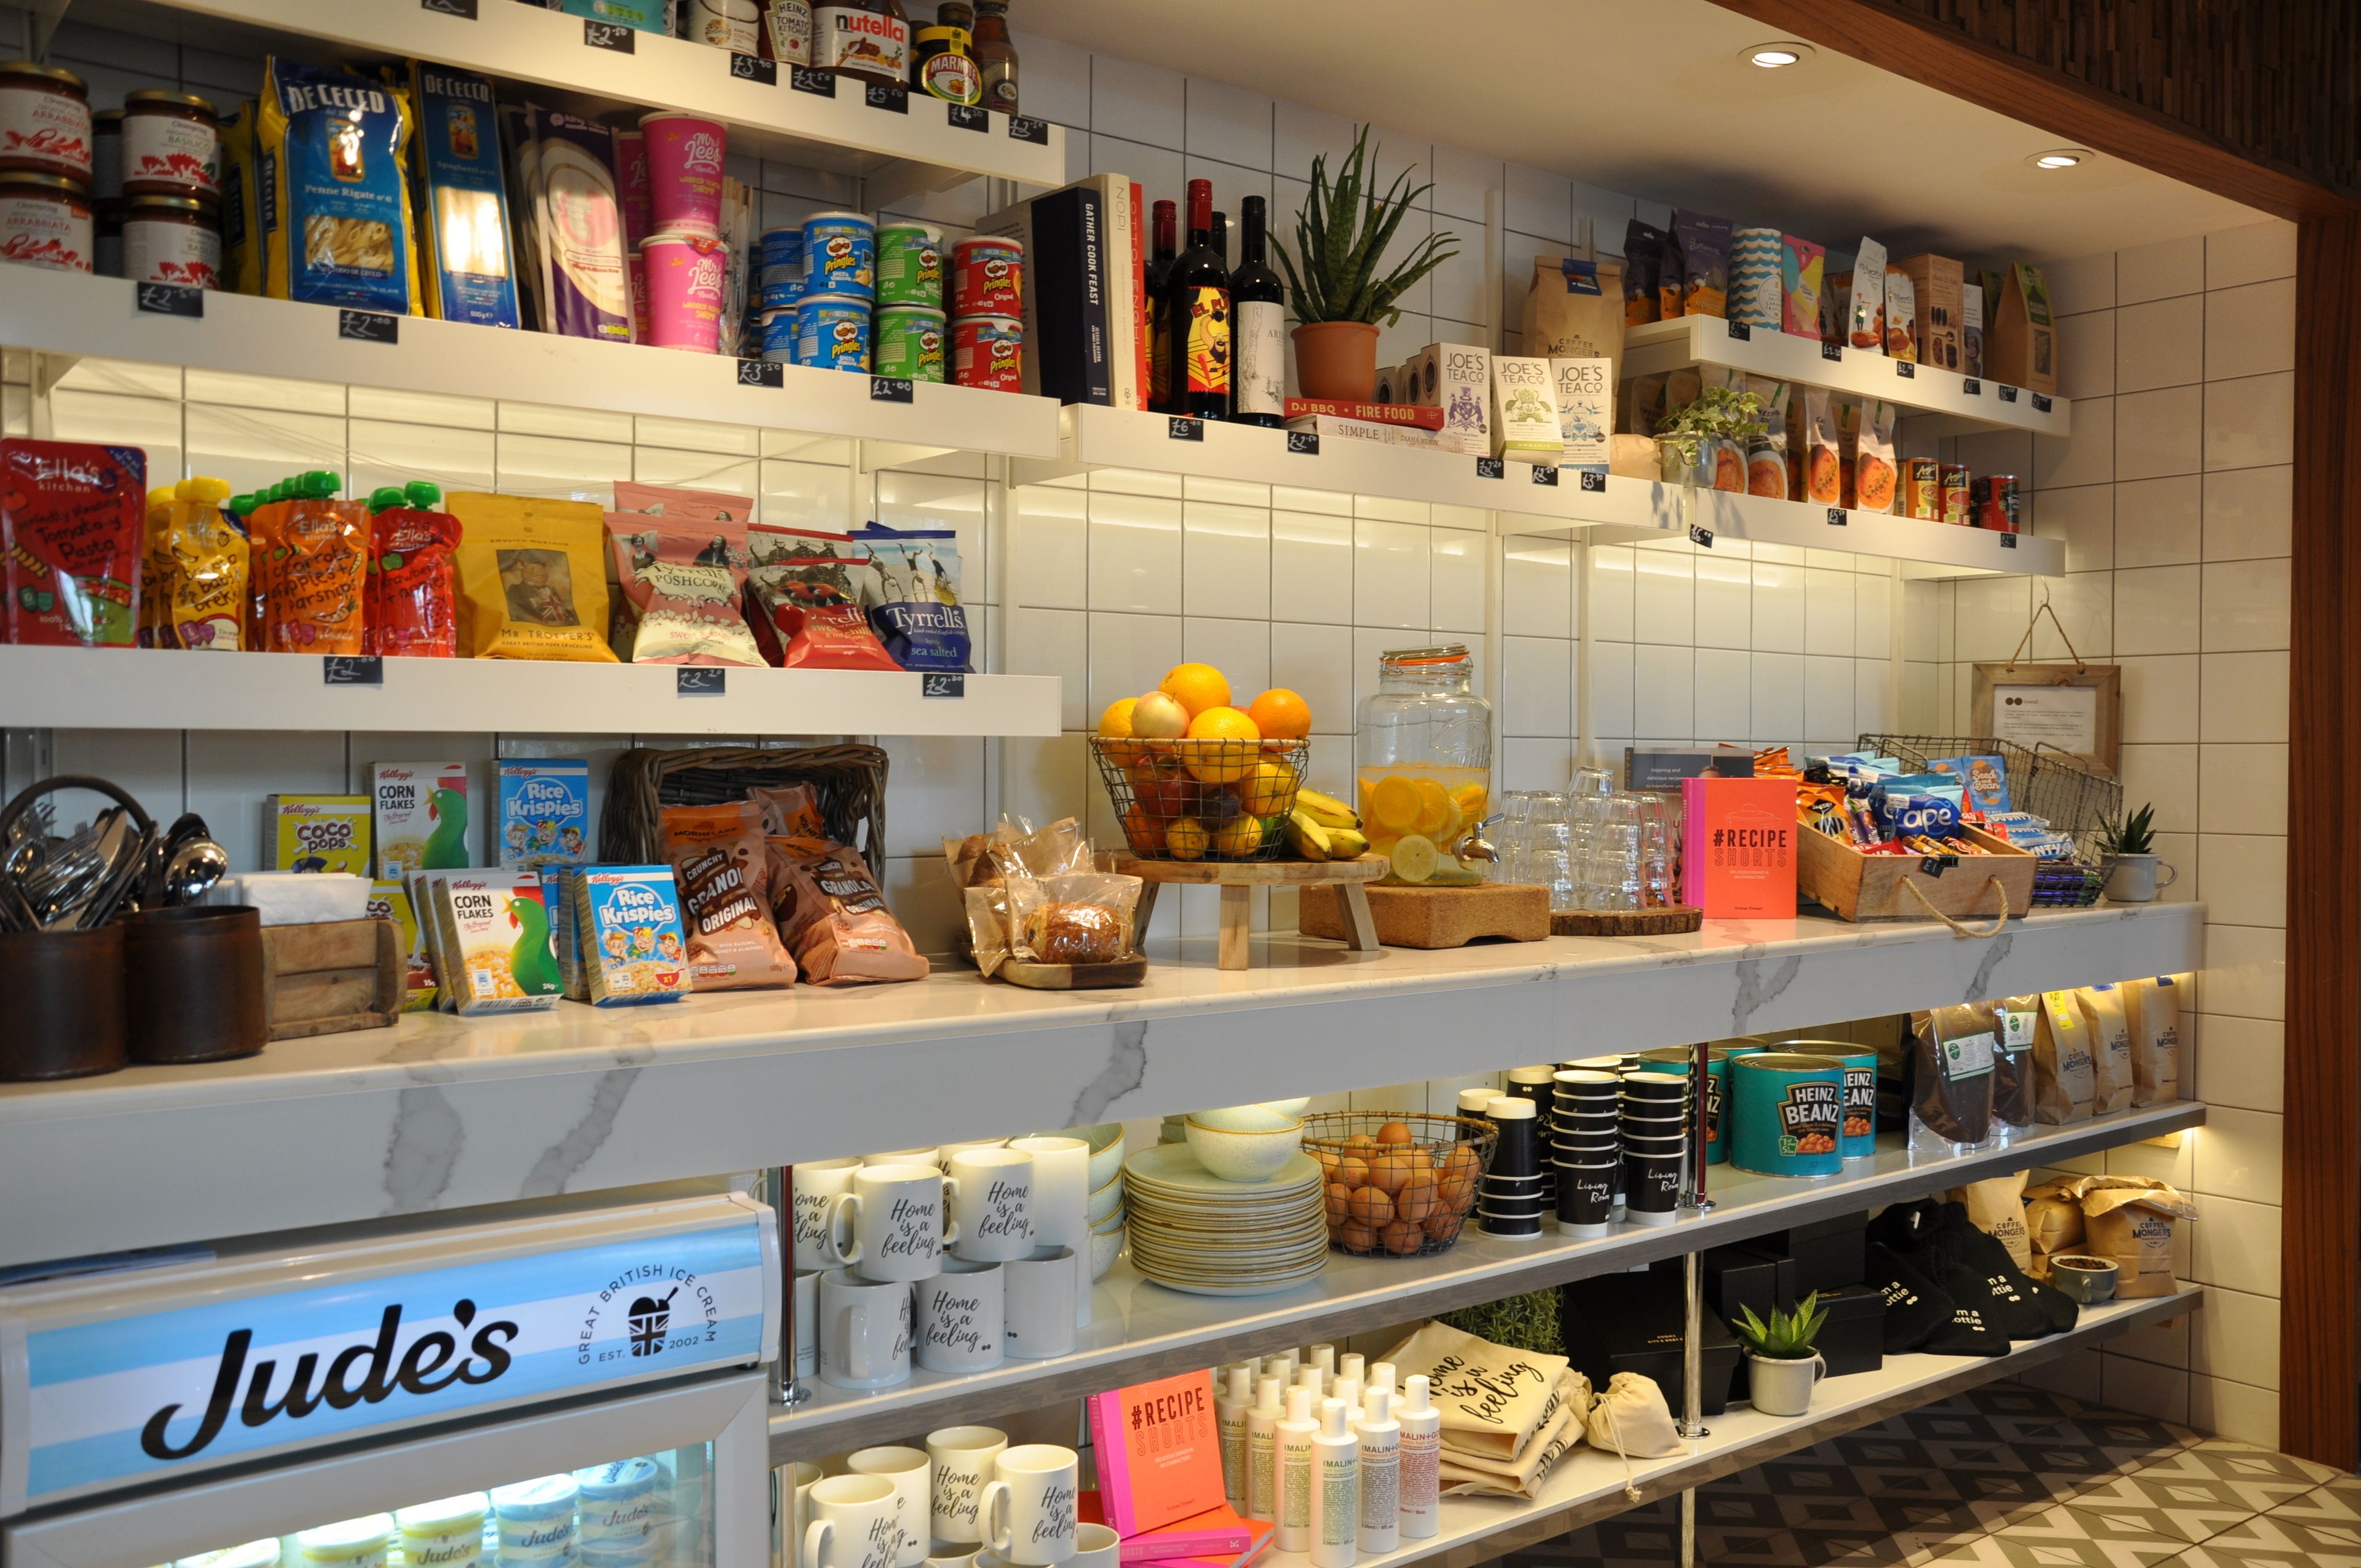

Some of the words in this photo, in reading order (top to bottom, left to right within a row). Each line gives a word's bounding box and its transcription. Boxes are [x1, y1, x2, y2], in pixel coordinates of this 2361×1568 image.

[779, 2, 807, 18] HEINZ
[778, 25, 808, 37] KETCHUP
[835, 14, 904, 43] nutella
[424, 74, 444, 95] DE
[446, 78, 490, 103] CECCO
[288, 85, 314, 114] DE
[317, 84, 386, 114] CECCO
[437, 160, 479, 174] Spaghetti
[305, 183, 341, 196] Penne
[342, 187, 375, 201] Rigate
[1116, 186, 1126, 231] NOPI
[1085, 203, 1096, 242] GATHER
[825, 256, 856, 276] Pringles
[1087, 245, 1096, 272] COOK
[983, 278, 1011, 295] Pringles
[1088, 274, 1099, 306] FEAST
[1191, 299, 1209, 319] EL
[831, 341, 861, 360] Pringles
[1559, 338, 1594, 349] COFFEE
[990, 358, 1016, 375] Pringles
[1447, 352, 1484, 371] JOE'S
[1501, 362, 1544, 376] JOE'S
[1447, 368, 1468, 381] TEA
[1501, 374, 1525, 384] TEA
[1557, 365, 1604, 382] JOE'S
[872, 378, 912, 397] £2.00
[1557, 382, 1583, 394] TEA
[1291, 402, 1307, 411] DJ
[1310, 404, 1337, 416] BBQ
[1356, 405, 1381, 418] FIRE
[1384, 407, 1415, 421] FOOD
[1338, 424, 1379, 440] SIMPLE
[1401, 435, 1420, 444] DIANA
[1420, 438, 1440, 446] HENRY
[35, 458, 100, 481] Ella's
[1915, 464, 1937, 478] Amy's
[1943, 470, 1966, 485] Amy's
[38, 480, 90, 494] kitchen
[35, 515, 122, 545] Tomato-y
[299, 518, 338, 534] Ella's
[396, 529, 432, 542] Ella's
[58, 538, 117, 563] Pasta
[198, 571, 235, 595] baby
[528, 630, 591, 641] TROTTER'S
[911, 647, 928, 656] sea
[929, 646, 958, 658] salted
[380, 769, 414, 781] Kellogg's
[503, 766, 539, 778] Kellogg's
[1972, 769, 1996, 781] Seed
[379, 784, 415, 799] CORN
[527, 782, 564, 801] Rice
[1972, 780, 2001, 791] Bean
[282, 804, 321, 817] Kellogg's
[379, 798, 415, 810] FLAKES
[509, 798, 583, 818] Krispies
[1904, 807, 1952, 833] ape
[674, 826, 738, 837] MORNFLAKE
[1713, 829, 1787, 848] #RECIPE
[307, 835, 347, 855] pops
[686, 852, 724, 881] CRUNCHY
[1714, 848, 1787, 867] SHORTS
[1923, 859, 1938, 873] £1
[452, 881, 488, 890] Kellogg's
[591, 874, 625, 885] Kellogg's
[820, 879, 876, 896] GRANOLA
[454, 895, 492, 909] CORN
[616, 889, 655, 907] Rice
[845, 897, 885, 914] ORIGINAL
[457, 909, 494, 920] FLAKES
[601, 906, 674, 925] Krispies
[702, 897, 758, 933] ORIGINAL
[1795, 1086, 1835, 1104] HEINZ
[1785, 1103, 1840, 1125] BEANZ
[1647, 1168, 1678, 1181] Living
[987, 1181, 1030, 1202] Home
[1576, 1178, 1608, 1192] Living
[1661, 1181, 1679, 1192] Room
[1590, 1192, 1610, 1204] Room
[890, 1198, 936, 1222] Home
[996, 1202, 1010, 1219] is
[1014, 1203, 1026, 1214] a
[900, 1219, 916, 1237] is
[919, 1221, 930, 1232] a
[978, 1212, 1030, 1239] feeling
[881, 1230, 936, 1259] feeling
[933, 1290, 981, 1312] Home
[578, 1305, 600, 1366] GREAT
[599, 1264, 663, 1303] BRITISH
[670, 1266, 696, 1287] ICE
[696, 1286, 718, 1342] CREAM
[940, 1311, 955, 1328] is
[959, 1313, 974, 1324] a
[925, 1323, 983, 1352] feeling
[598, 1349, 625, 1363] EST.
[668, 1336, 699, 1350] 2002
[140, 1299, 520, 1461] Jude's
[1442, 1378, 1477, 1398] is
[1466, 1366, 1488, 1378] a
[1460, 1361, 1544, 1424] feeling
[1130, 1387, 1205, 1431] #RECIPE
[1135, 1412, 1208, 1457] SHORTS
[936, 1465, 981, 1486] Home
[942, 1484, 957, 1500] is
[960, 1487, 974, 1498] a
[1041, 1485, 1077, 1509] Home
[602, 1504, 650, 1527] Jude's
[931, 1496, 979, 1525] feeling
[1049, 1506, 1064, 1522] is
[1065, 1503, 1074, 1514] a
[521, 1523, 572, 1548] Jude's
[1032, 1518, 1078, 1544] feeling
[417, 1543, 471, 1566] Jude's
